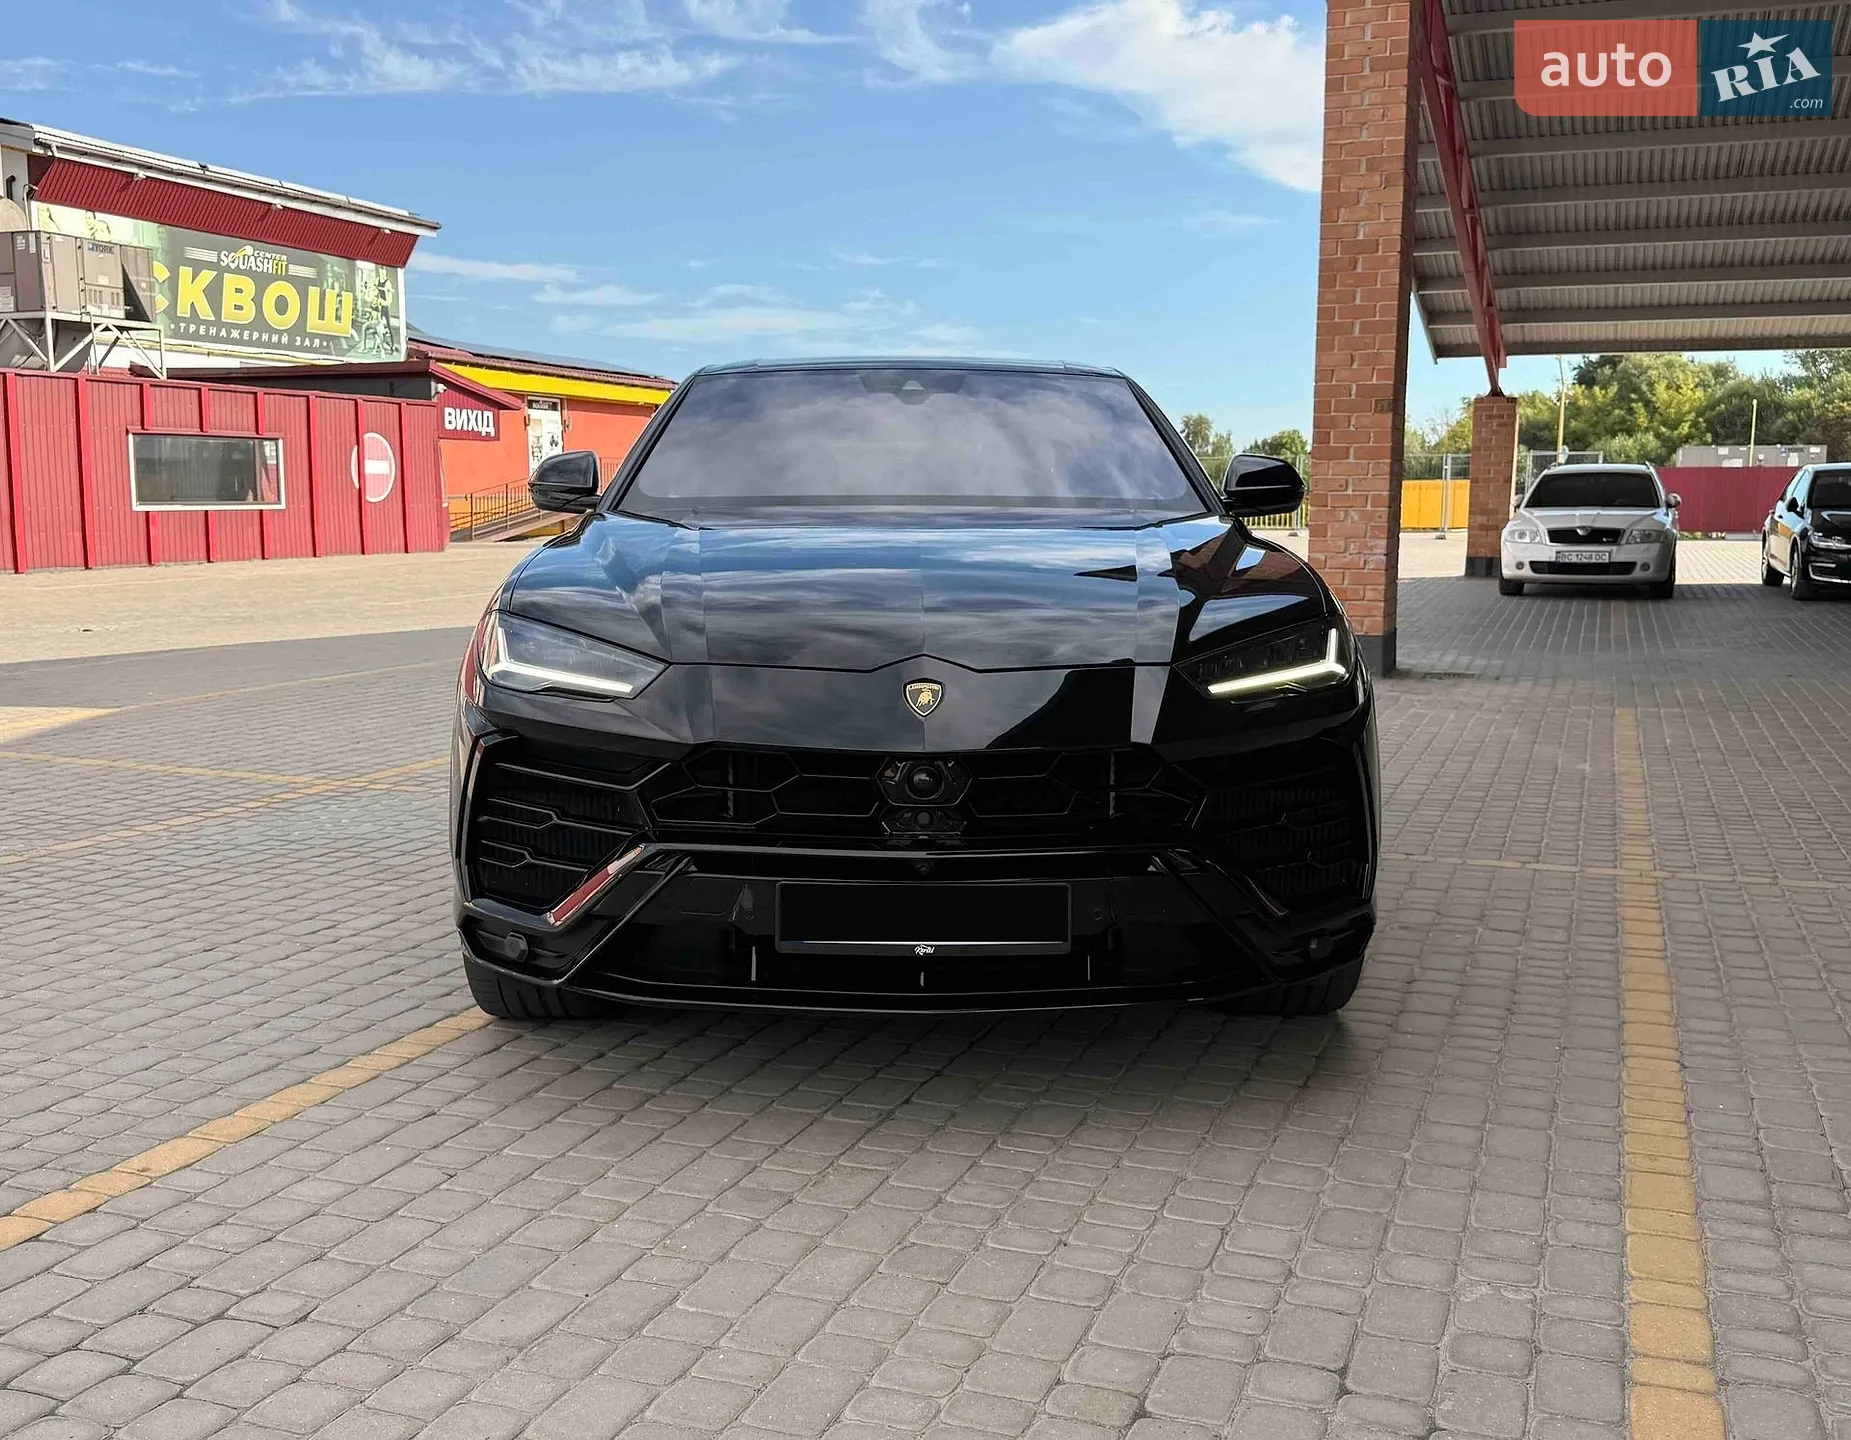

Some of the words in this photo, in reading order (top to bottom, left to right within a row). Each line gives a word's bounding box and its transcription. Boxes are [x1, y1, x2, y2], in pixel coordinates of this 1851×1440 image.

[254, 250, 287, 261] CENTER
[179, 322, 289, 345] ТРЕНАЖЕРНИЙ
[295, 336, 320, 348] ЗАЛ
[444, 406, 495, 437] ВИХІД
